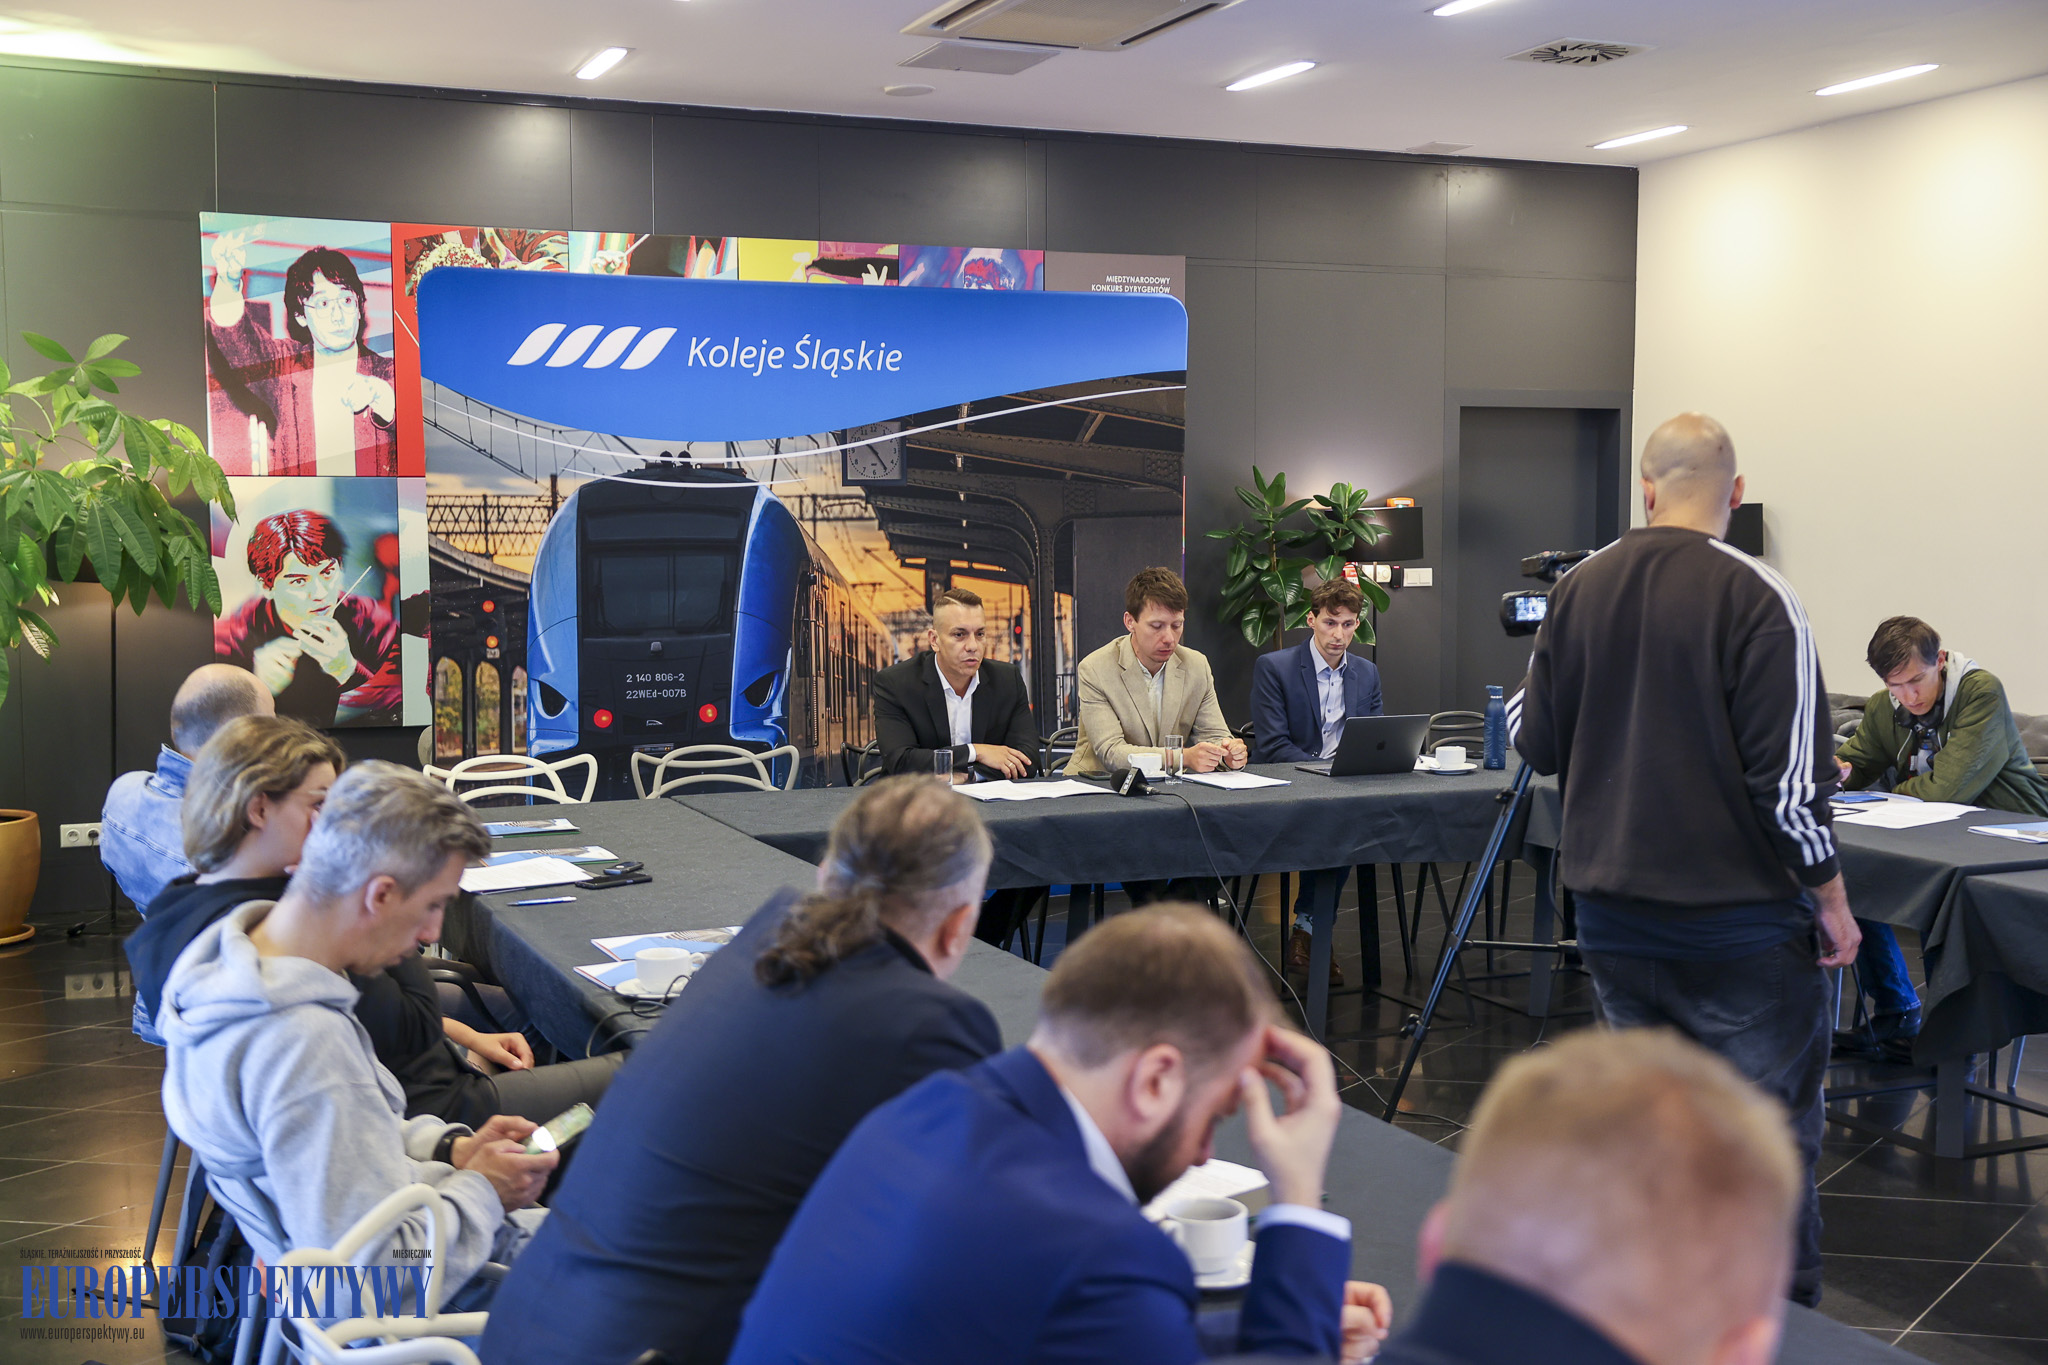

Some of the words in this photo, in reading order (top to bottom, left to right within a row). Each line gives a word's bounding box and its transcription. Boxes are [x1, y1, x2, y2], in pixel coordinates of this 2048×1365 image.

[1105, 275, 1170, 284] MIĘDZYNARODOWY
[1091, 284, 1123, 292] KONKURS
[1124, 285, 1170, 293] DYRYGENTÓW
[687, 336, 785, 377] Koleje
[792, 333, 903, 379] Śląskie
[626, 674, 632, 682] 2
[636, 673, 651, 682] 140
[655, 673, 685, 681] 806-2
[626, 689, 687, 699] 22WEd-007B
